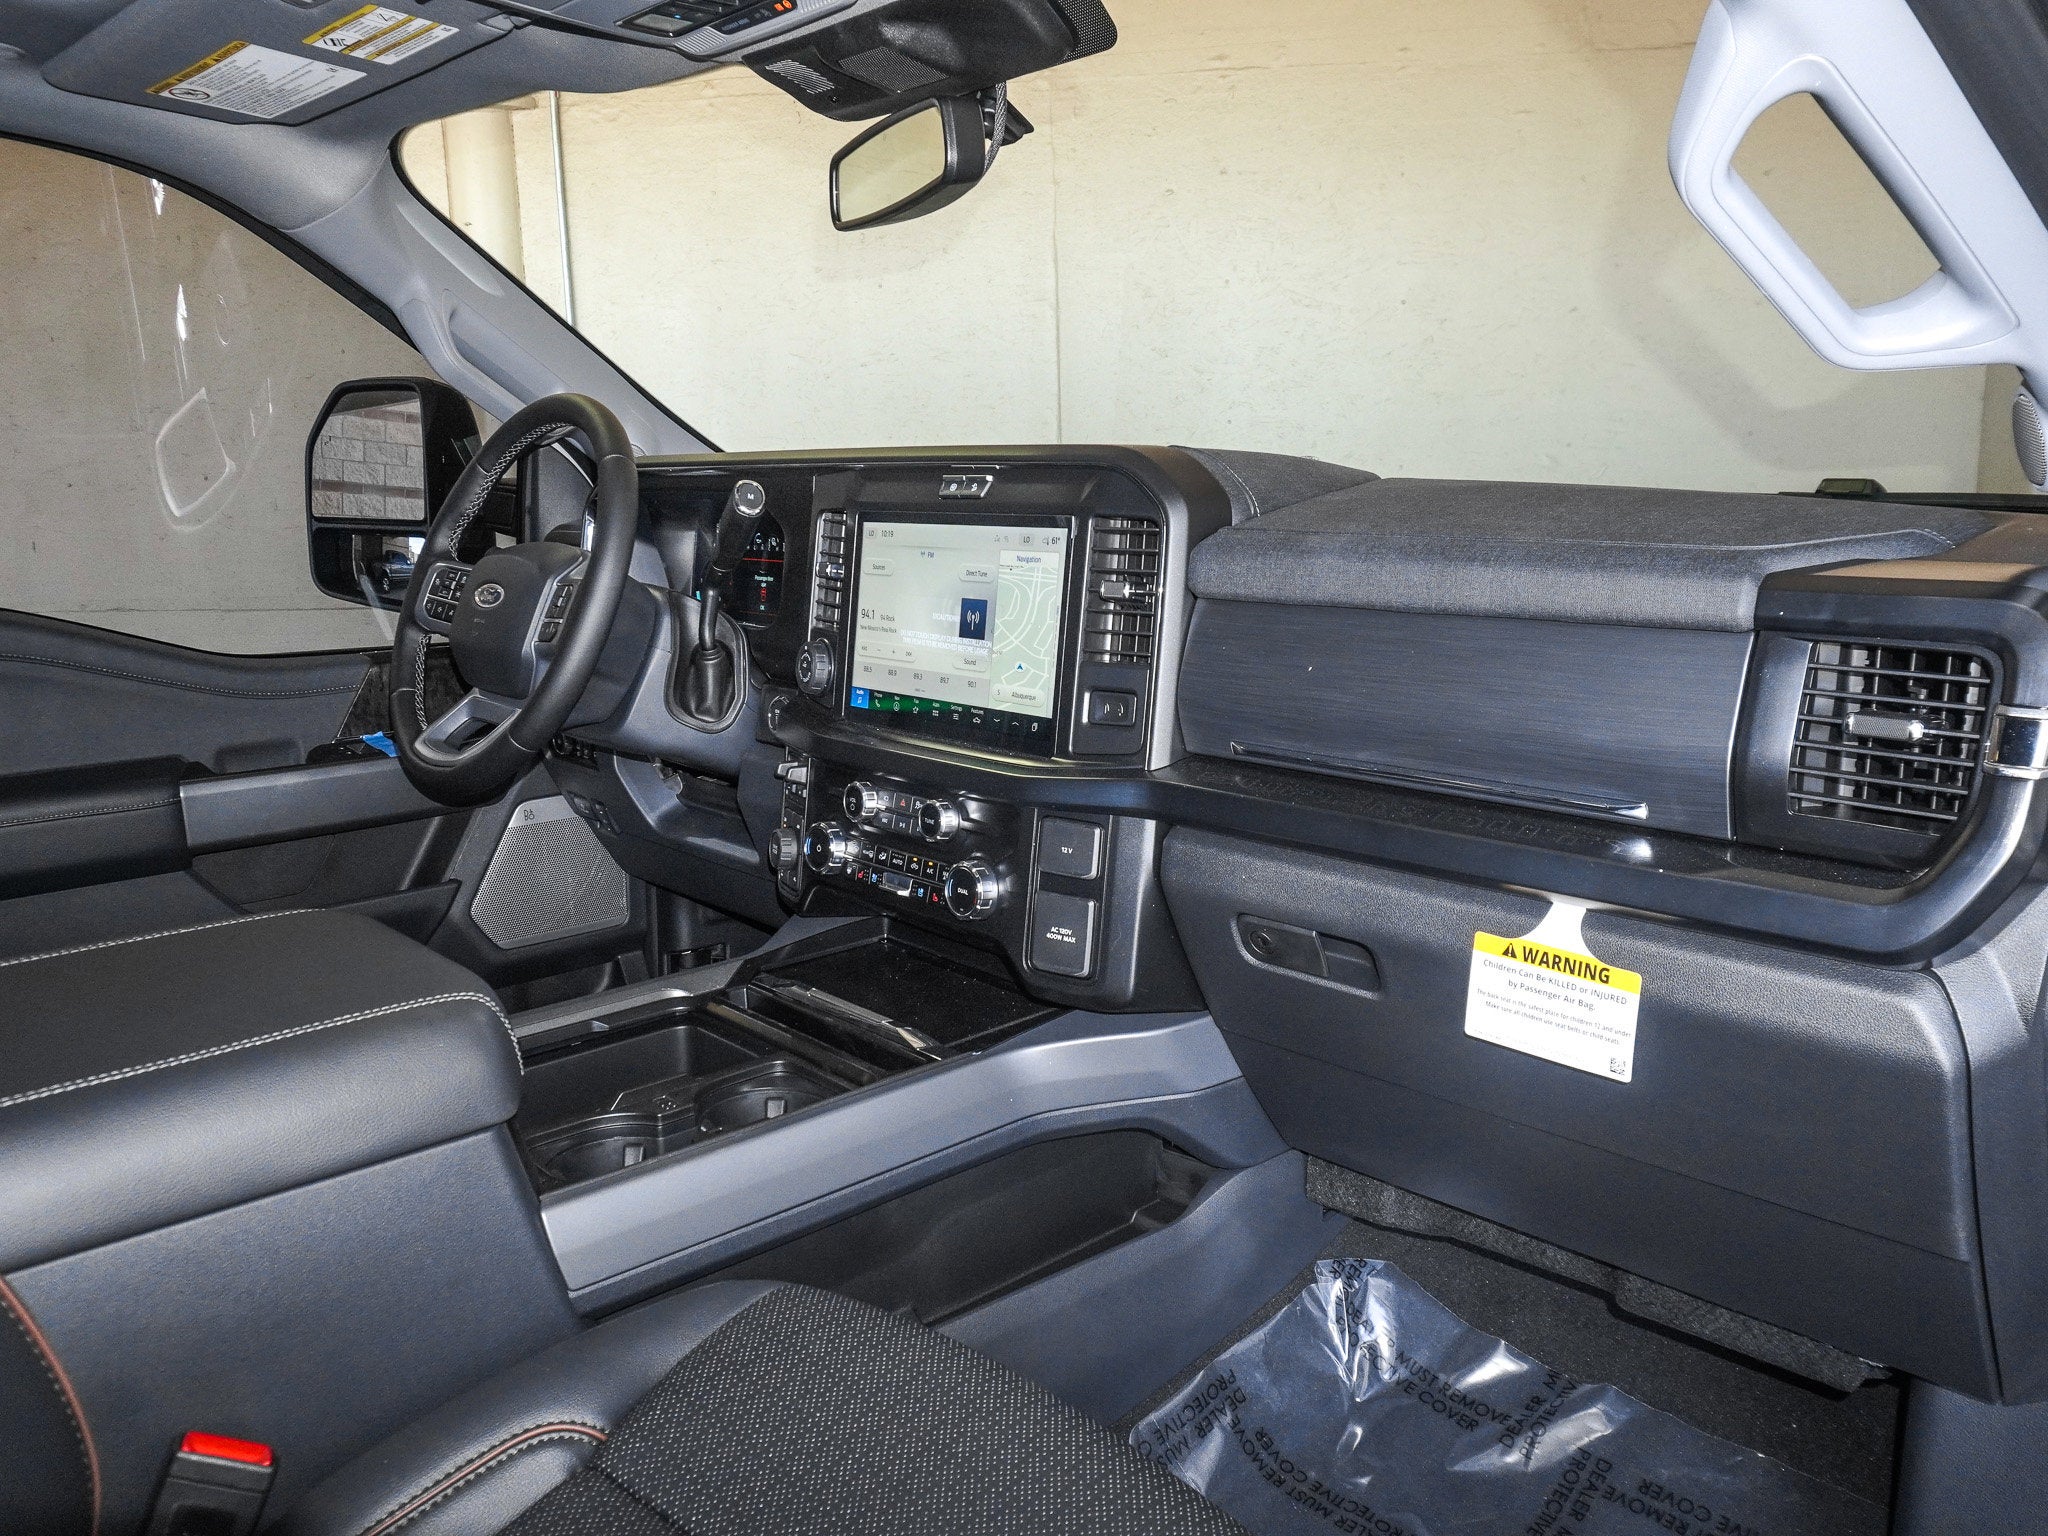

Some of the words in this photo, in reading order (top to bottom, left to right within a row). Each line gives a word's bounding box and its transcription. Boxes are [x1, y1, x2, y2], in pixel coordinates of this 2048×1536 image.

[1016, 555, 1042, 564] Navigation
[861, 608, 875, 620] 94.1
[963, 658, 977, 666] Sound
[1012, 691, 1037, 701] Albuquerque
[957, 887, 969, 896] DUAL
[1046, 932, 1062, 941] 400W
[1063, 935, 1077, 943] MAX
[1059, 928, 1073, 936] 120V
[1483, 959, 1517, 974] Children
[1518, 969, 1534, 980] Can
[1536, 973, 1546, 982] Be
[1548, 977, 1577, 991] KILLED
[1579, 986, 1589, 994] or
[1591, 988, 1628, 1005] INJURED
[1522, 945, 1610, 984] WARNING
[1508, 979, 1518, 989] by
[1520, 983, 1561, 1001] Passenger
[1563, 995, 1575, 1004] Air
[1578, 999, 1596, 1012] Bag.
[1615, 1029, 1631, 1038] under
[1153, 1369, 1237, 1446] PROTECTIVE
[1396, 1351, 1440, 1387] MUST
[1438, 1382, 1513, 1426] REMOVE
[1194, 1387, 1246, 1440] DEALER
[1419, 1391, 1480, 1431] COVER
[1499, 1396, 1546, 1449] DEALER
[1520, 1380, 1578, 1461] PROTECTIV
[1157, 1436, 1192, 1470] MUS
[1227, 1415, 1287, 1489] REMOVE
[1255, 1427, 1308, 1484] COVER
[1285, 1487, 1333, 1519] MUST
[1309, 1480, 1404, 1536] ROTECTIVE
[1569, 1459, 1613, 1522] DEALER
[1602, 1485, 1690, 1536] REMOVE
[1638, 1478, 1712, 1522] COVER
